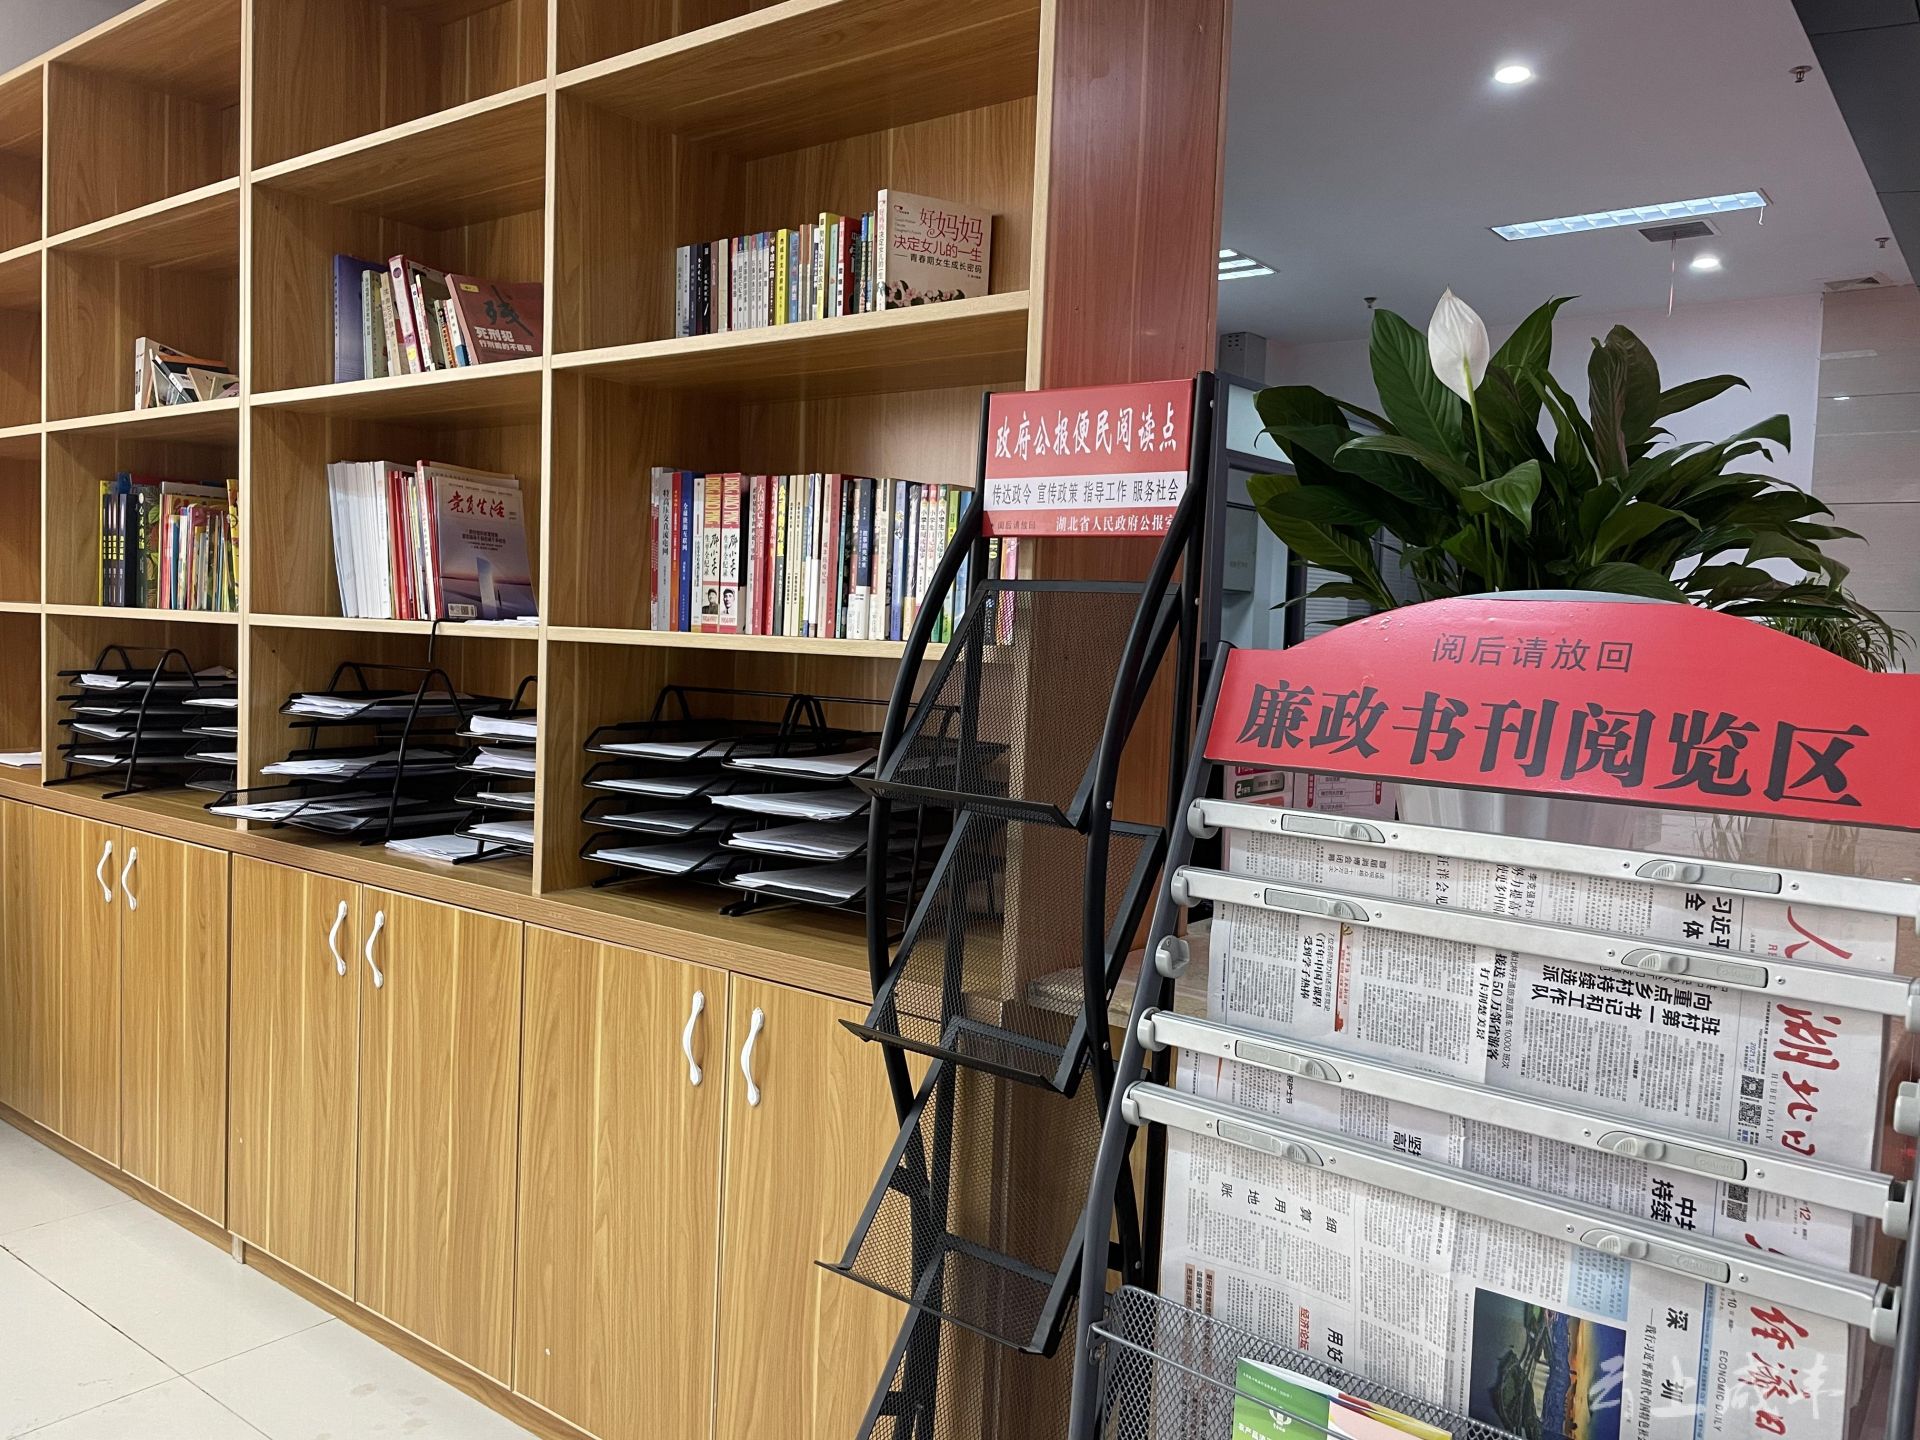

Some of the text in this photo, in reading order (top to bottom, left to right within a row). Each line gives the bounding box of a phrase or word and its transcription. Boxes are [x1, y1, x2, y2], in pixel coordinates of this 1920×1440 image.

[894, 235, 982, 263] 决定女儿的一生
[920, 208, 983, 247] 好妈妈
[474, 326, 515, 342] 死刑犯
[994, 401, 1177, 461] 政府公报便民阅读点
[992, 478, 1179, 505] 传达政令 宣传政策 指导工作 服务社会
[1432, 632, 1633, 674] 阅后请放回
[1235, 679, 1872, 808] 廉政书刊阅览区
[1507, 866, 1526, 917] 努力提高
[1299, 934, 1314, 1000] 受到学子热捧
[1311, 931, 1326, 1008] 《百年中国》课程
[1542, 964, 1712, 1011] 向重点乡村持续选派
[1531, 983, 1721, 1036] 驻村第一书记和工作队
[1764, 1073, 1780, 1142] HUBEI DAILY
[1649, 1177, 1674, 1223] 持续
[1299, 1306, 1311, 1351] 经济论坛
[1326, 1327, 1344, 1364] 用好
[1713, 1349, 1729, 1432] ECONOMIC DAILY
